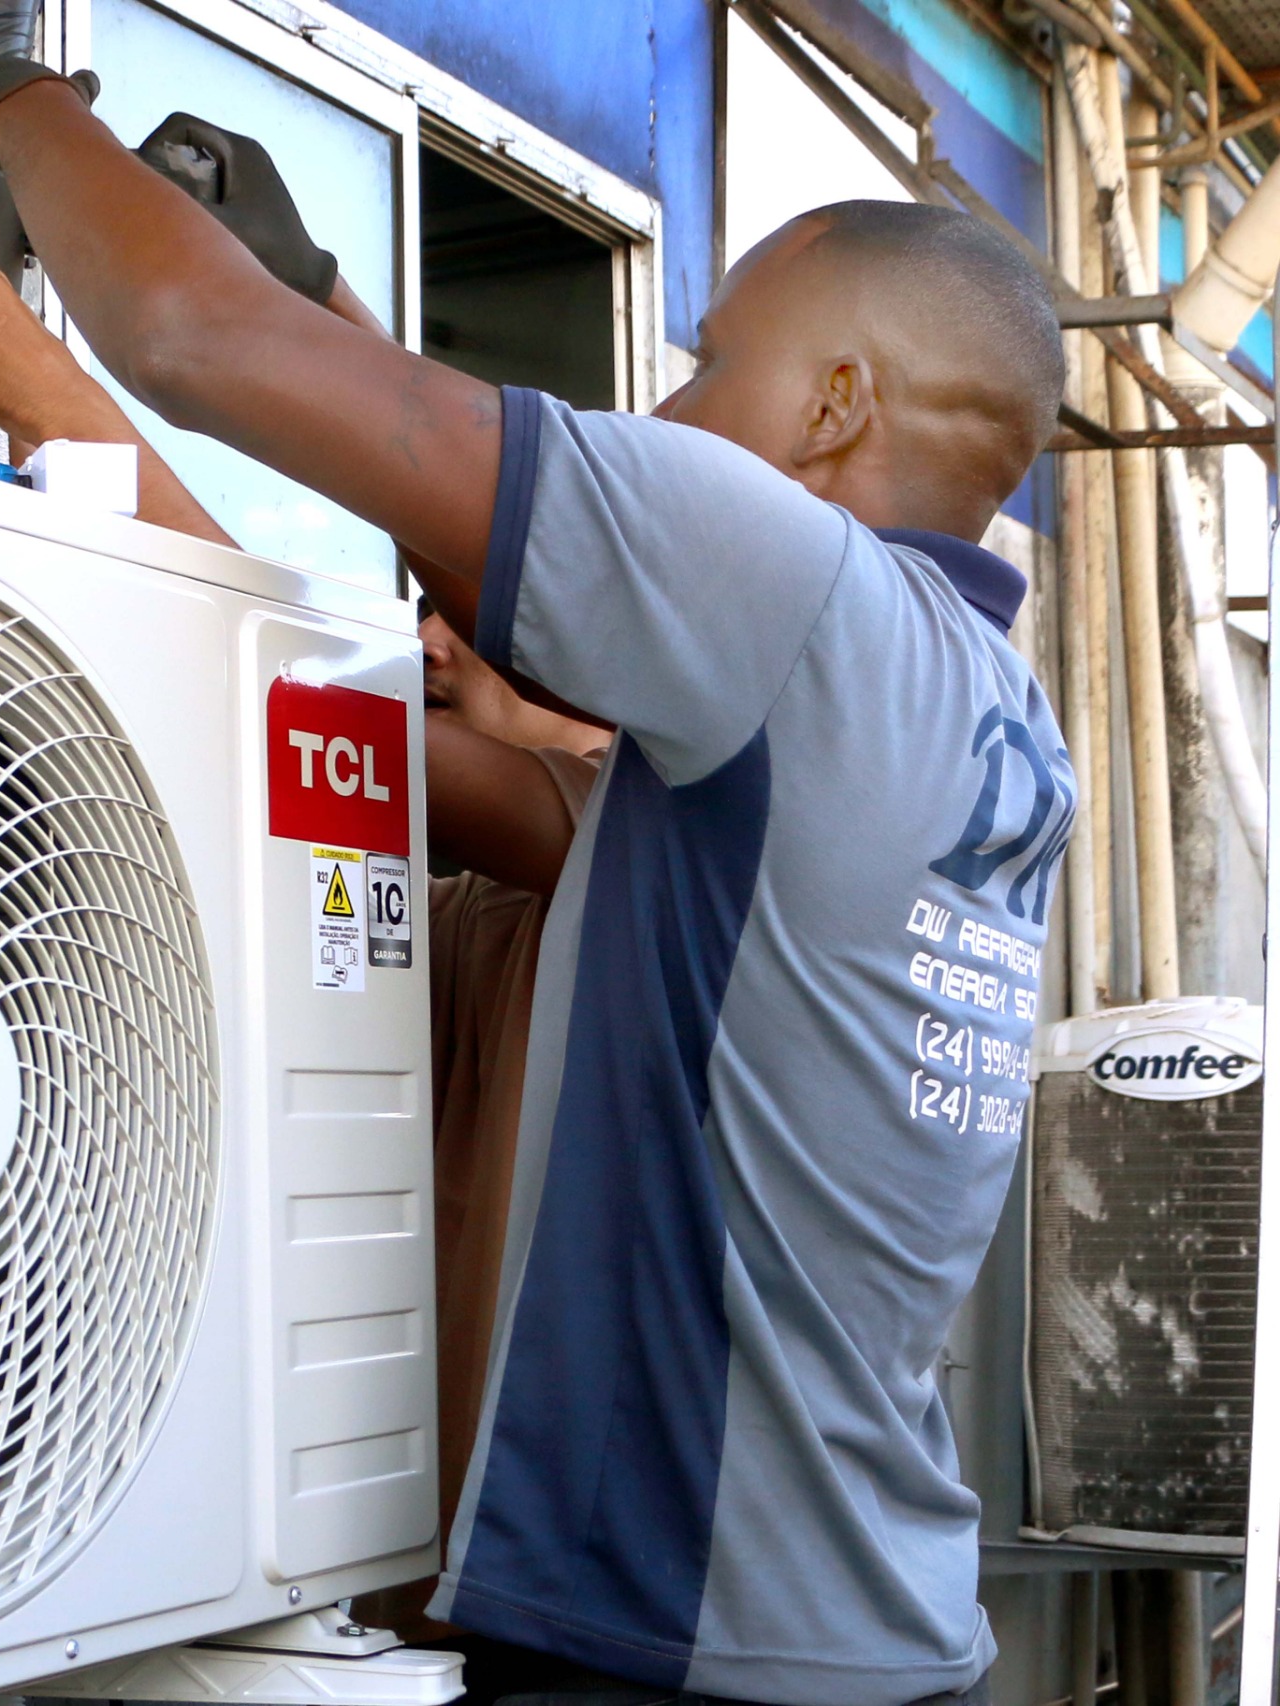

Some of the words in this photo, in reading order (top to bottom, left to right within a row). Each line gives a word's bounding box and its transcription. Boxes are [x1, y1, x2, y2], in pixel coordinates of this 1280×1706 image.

[289, 728, 389, 802] TCL
[317, 871, 328, 884] R32
[371, 866, 405, 877] COMPRESSOR
[386, 928, 394, 936] DE
[905, 898, 952, 942] DW
[374, 950, 406, 961] GARANTIA
[909, 951, 1007, 1015] ENERGIA
[916, 1012, 973, 1076] (24)
[1094, 1045, 1245, 1080] comfee
[909, 1069, 971, 1135] (24)
